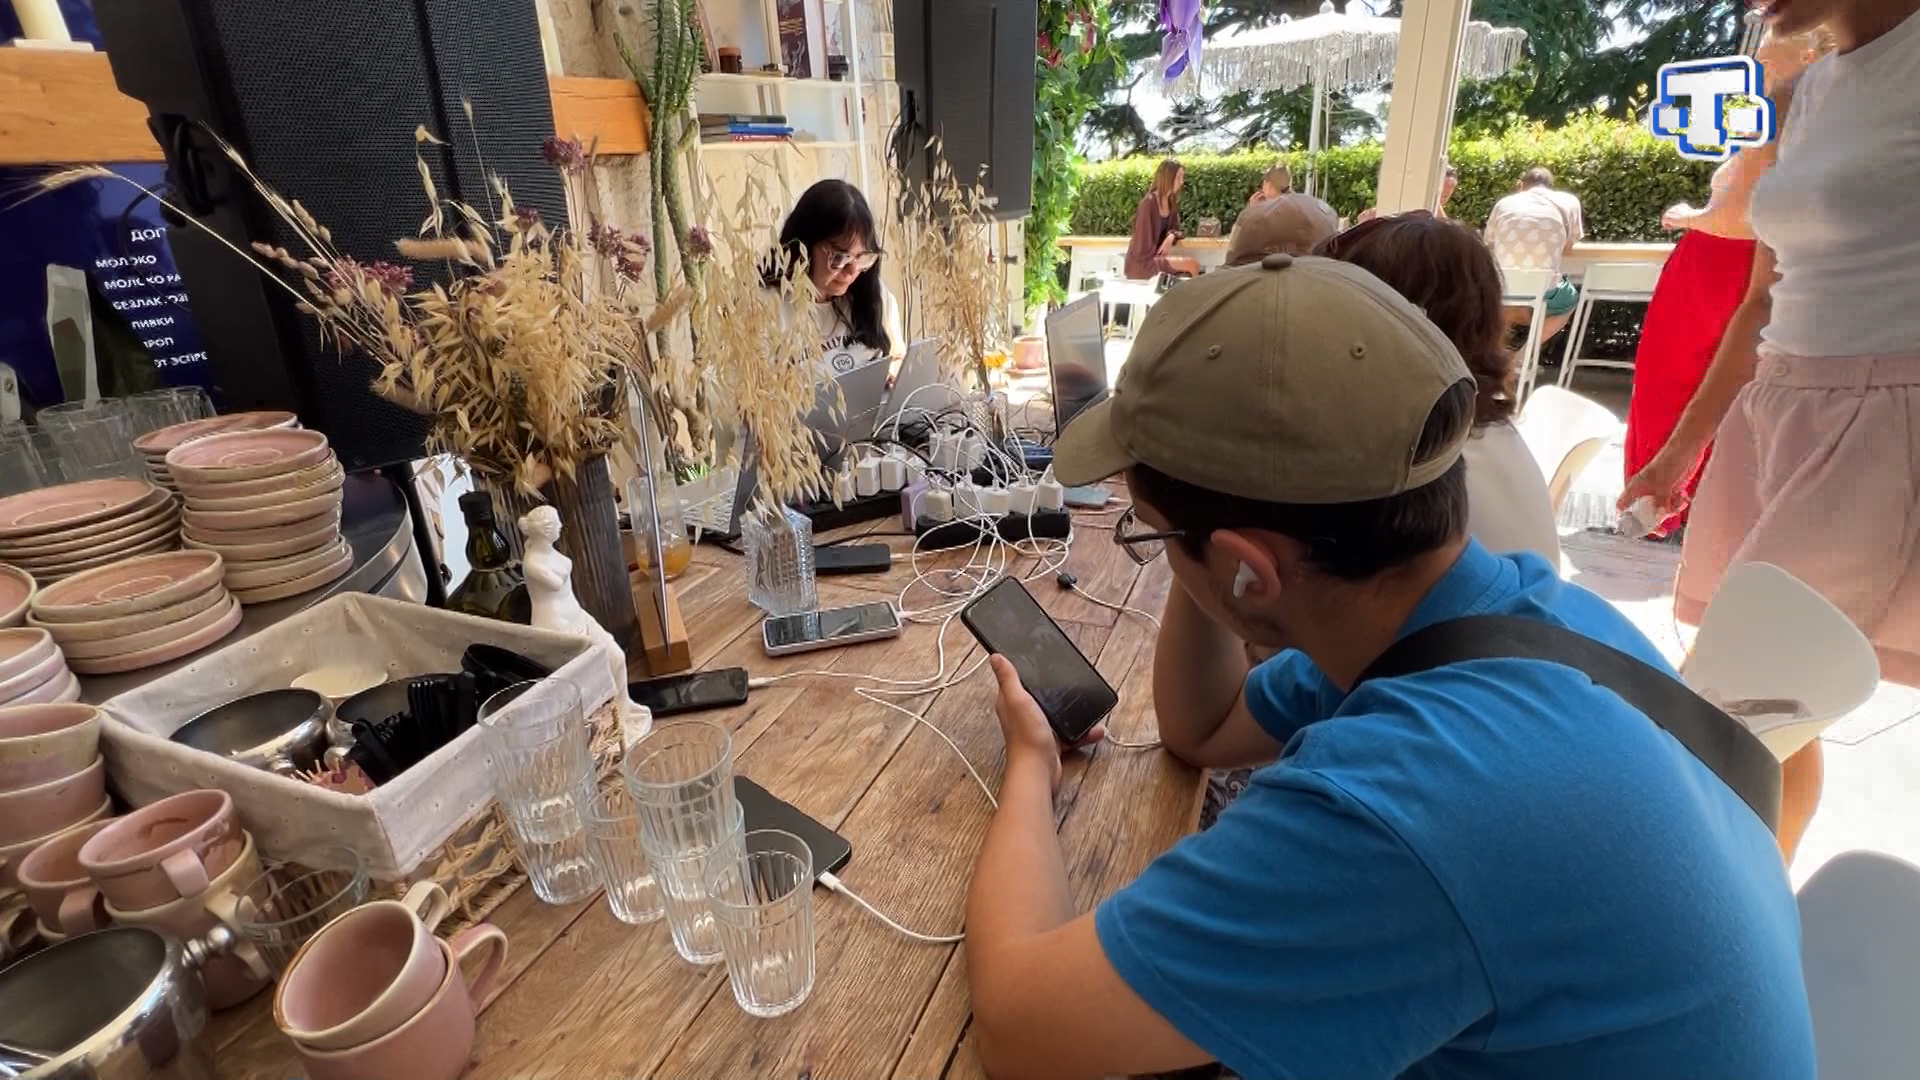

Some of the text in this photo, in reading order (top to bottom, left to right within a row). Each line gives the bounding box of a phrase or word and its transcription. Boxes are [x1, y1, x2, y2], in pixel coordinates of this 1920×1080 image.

[130, 227, 166, 242] ДОП
[96, 255, 157, 268] МОЛОКО
[131, 316, 175, 329] ЛИВКИ
[170, 351, 208, 366] ЭСПРЕ
